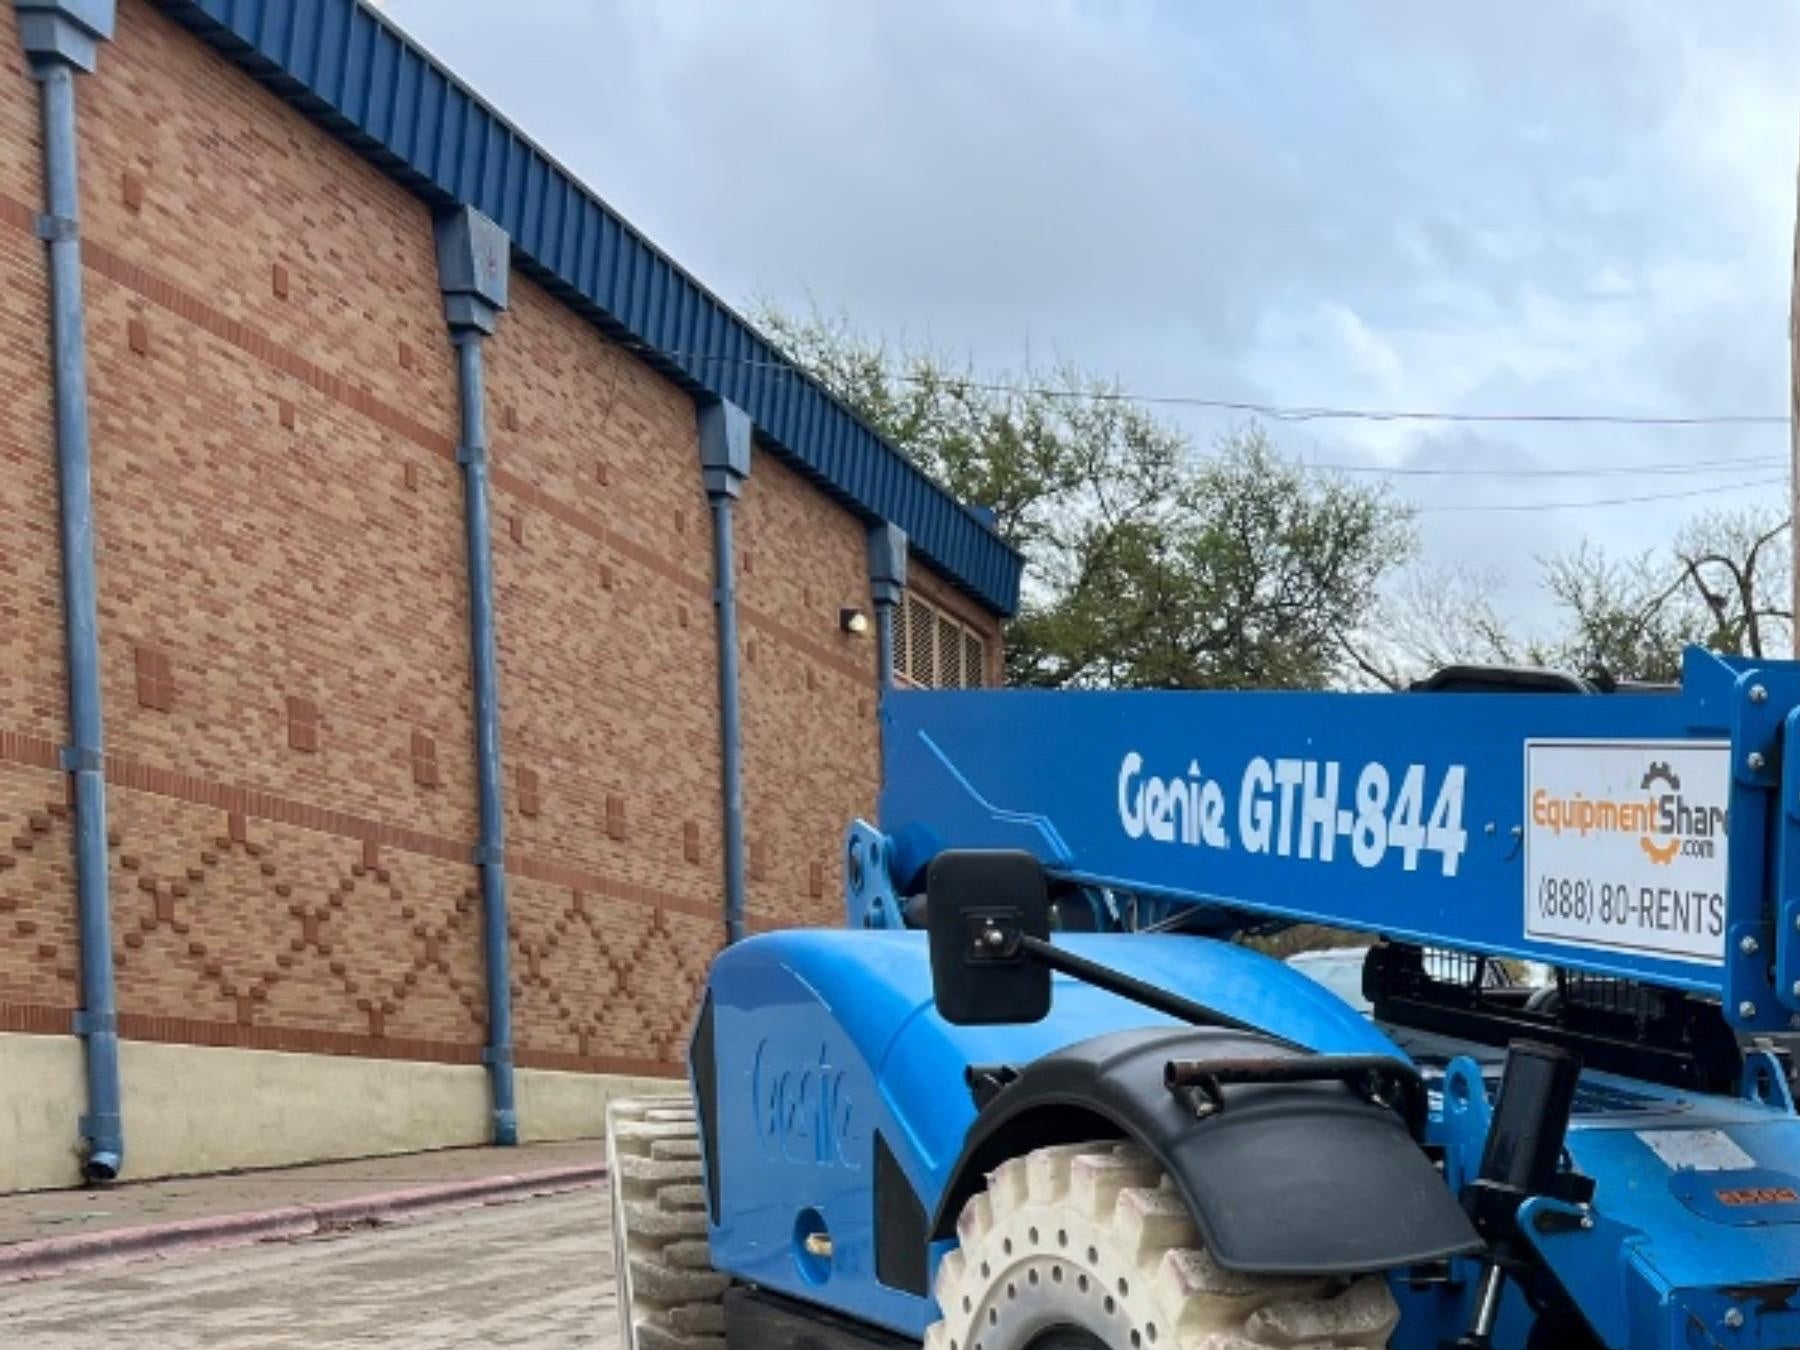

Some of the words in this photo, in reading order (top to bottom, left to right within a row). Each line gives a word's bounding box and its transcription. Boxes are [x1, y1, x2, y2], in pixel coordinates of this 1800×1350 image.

[1118, 751, 1230, 849] Genie
[1238, 756, 1467, 877] GTH-844
[1538, 875, 1594, 925] (888)
[1599, 882, 1724, 937] 80-RENTS
